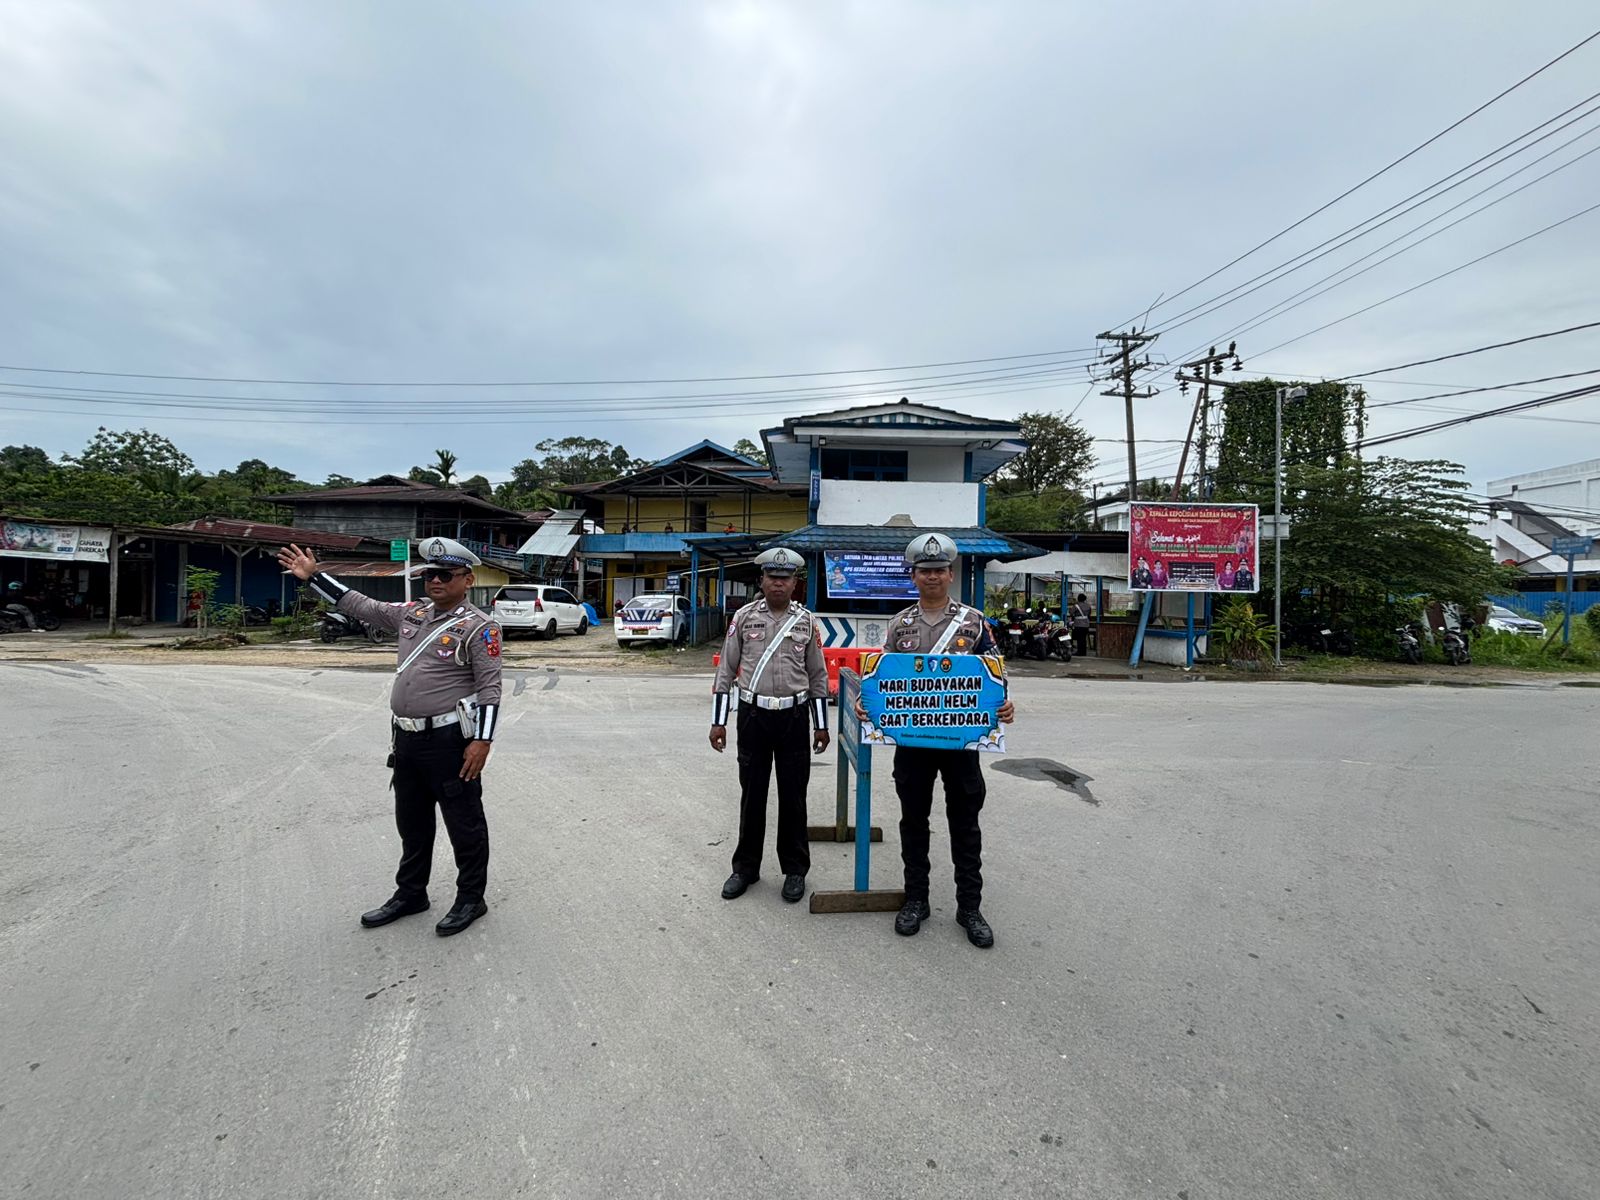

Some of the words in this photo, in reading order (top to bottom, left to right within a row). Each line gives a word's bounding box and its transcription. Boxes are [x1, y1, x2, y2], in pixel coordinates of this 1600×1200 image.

[1151, 531, 1175, 543] Selamat
[879, 680, 907, 693] MARI
[911, 677, 982, 692] BUDAYAKAN
[885, 695, 940, 709] MEMAKAI
[944, 694, 977, 708] HELM
[880, 714, 909, 727] SAAT
[912, 712, 989, 726] BERKENDARA
